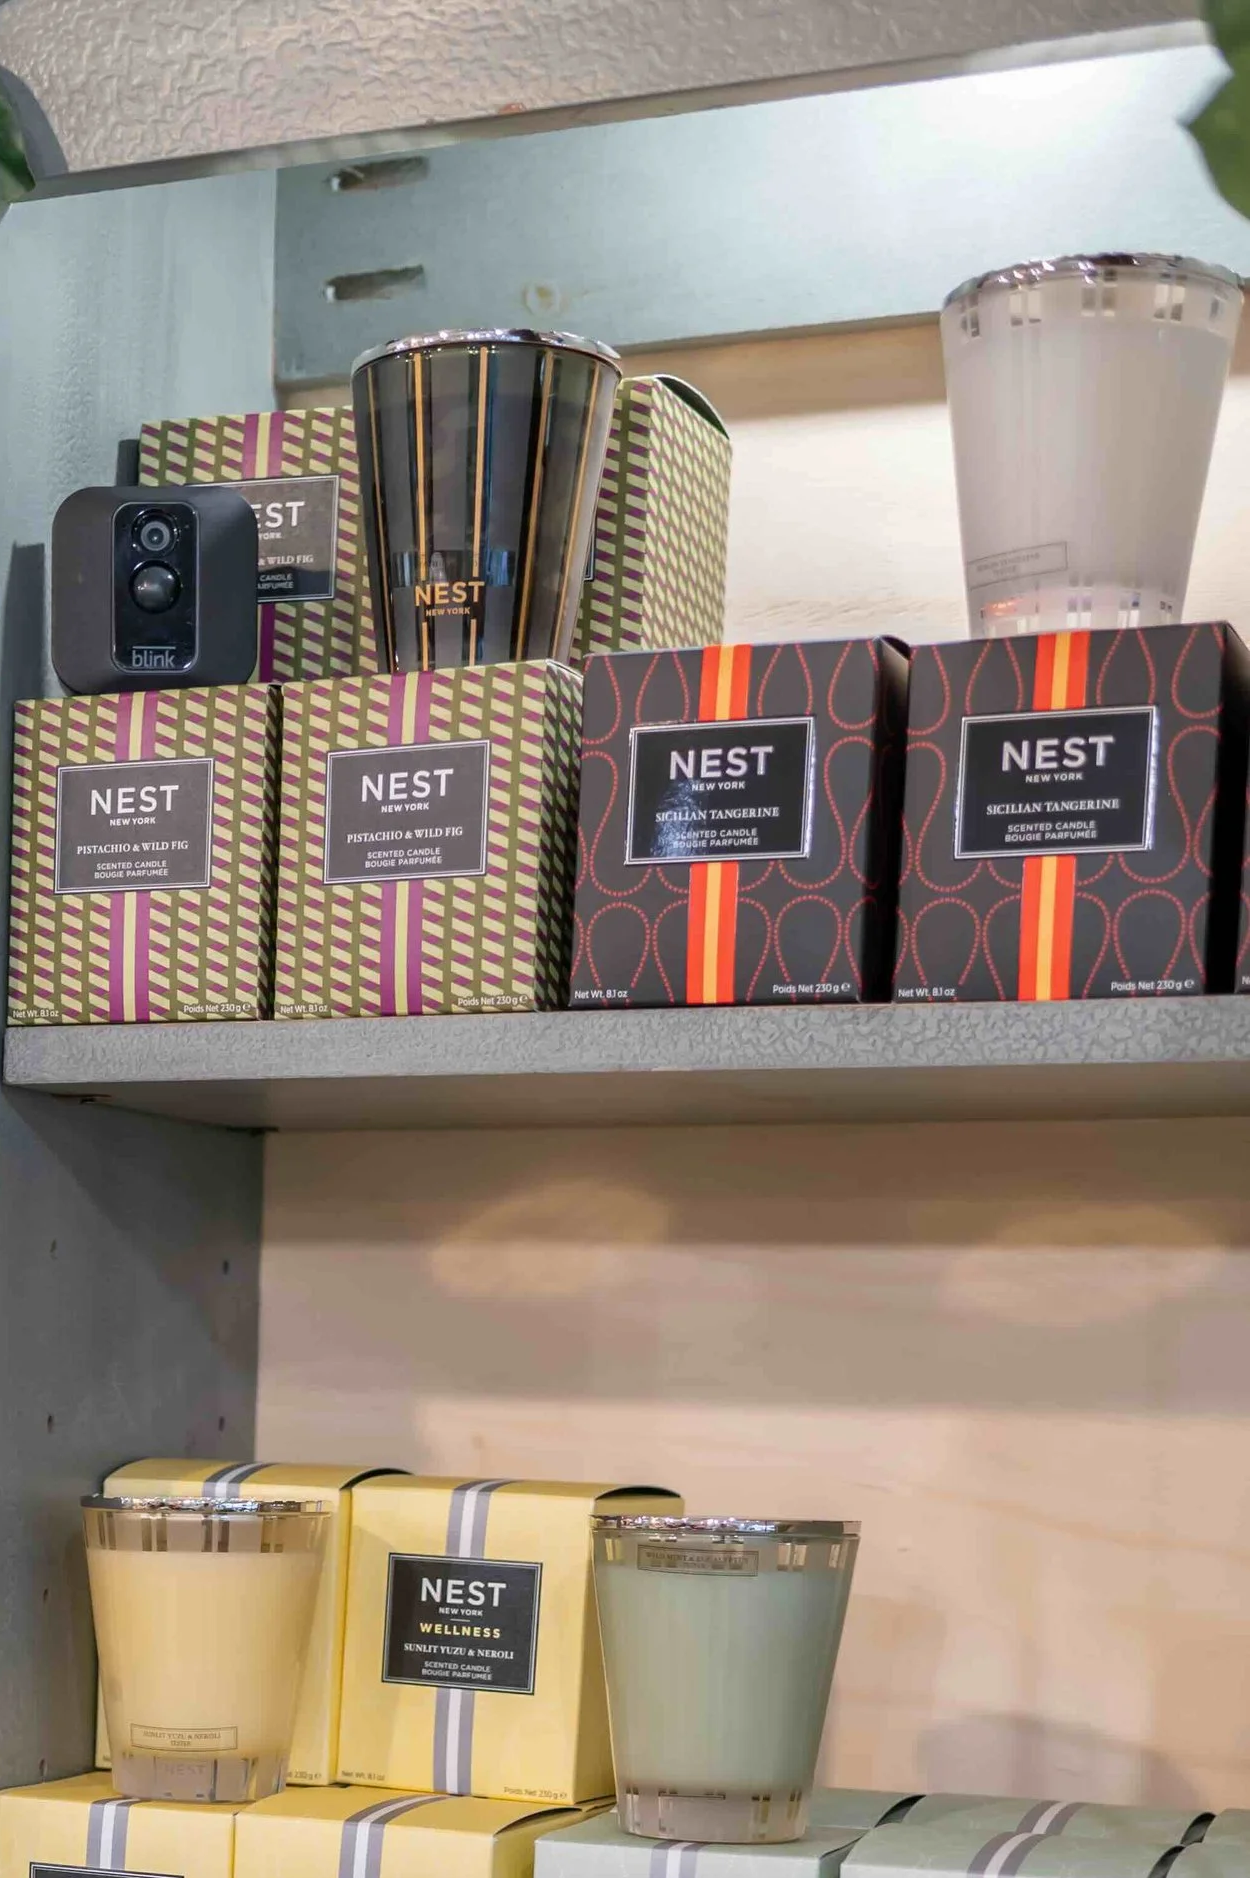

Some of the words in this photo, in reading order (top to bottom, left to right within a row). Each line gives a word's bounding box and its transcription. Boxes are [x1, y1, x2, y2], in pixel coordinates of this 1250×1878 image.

[415, 582, 485, 606] NEST
[447, 607, 470, 615] YORK
[132, 650, 175, 668] blink
[1002, 736, 1115, 772] NEST
[669, 746, 774, 780] NEST
[362, 769, 453, 802] NEST
[1026, 775, 1050, 783] NEW
[1053, 773, 1083, 781] YORK
[692, 783, 715, 791] NEW
[718, 781, 745, 789] YORK
[90, 785, 179, 815] NEST
[986, 802, 1042, 815] SICILIAN
[1044, 799, 1120, 812] TANGERINE
[381, 805, 402, 813] NEW
[405, 803, 429, 811] YORK
[655, 810, 707, 823] SICILIAN
[709, 807, 780, 819] TANGERINE
[132, 817, 156, 825] YORK
[1008, 823, 1051, 833] SCENTED
[1055, 821, 1096, 830] CANDLE
[347, 830, 402, 843] PISTACHIO
[414, 829, 442, 839] WILD
[445, 827, 463, 836] FIG
[1005, 833, 1041, 842] BOUGIE
[77, 843, 130, 855] PISTACHIO
[133, 844, 140, 852] &
[141, 842, 169, 851] WILD
[171, 841, 189, 850] FIG
[367, 850, 405, 859] SCENTED
[407, 848, 441, 856] CANDLE
[365, 859, 395, 868] BOUGIE
[421, 1577, 506, 1607] NEST
[420, 1623, 501, 1638] WELLNESS
[404, 1643, 438, 1653] SUNLIT
[440, 1646, 466, 1656] YUZU
[477, 1649, 514, 1659] NEROLI
